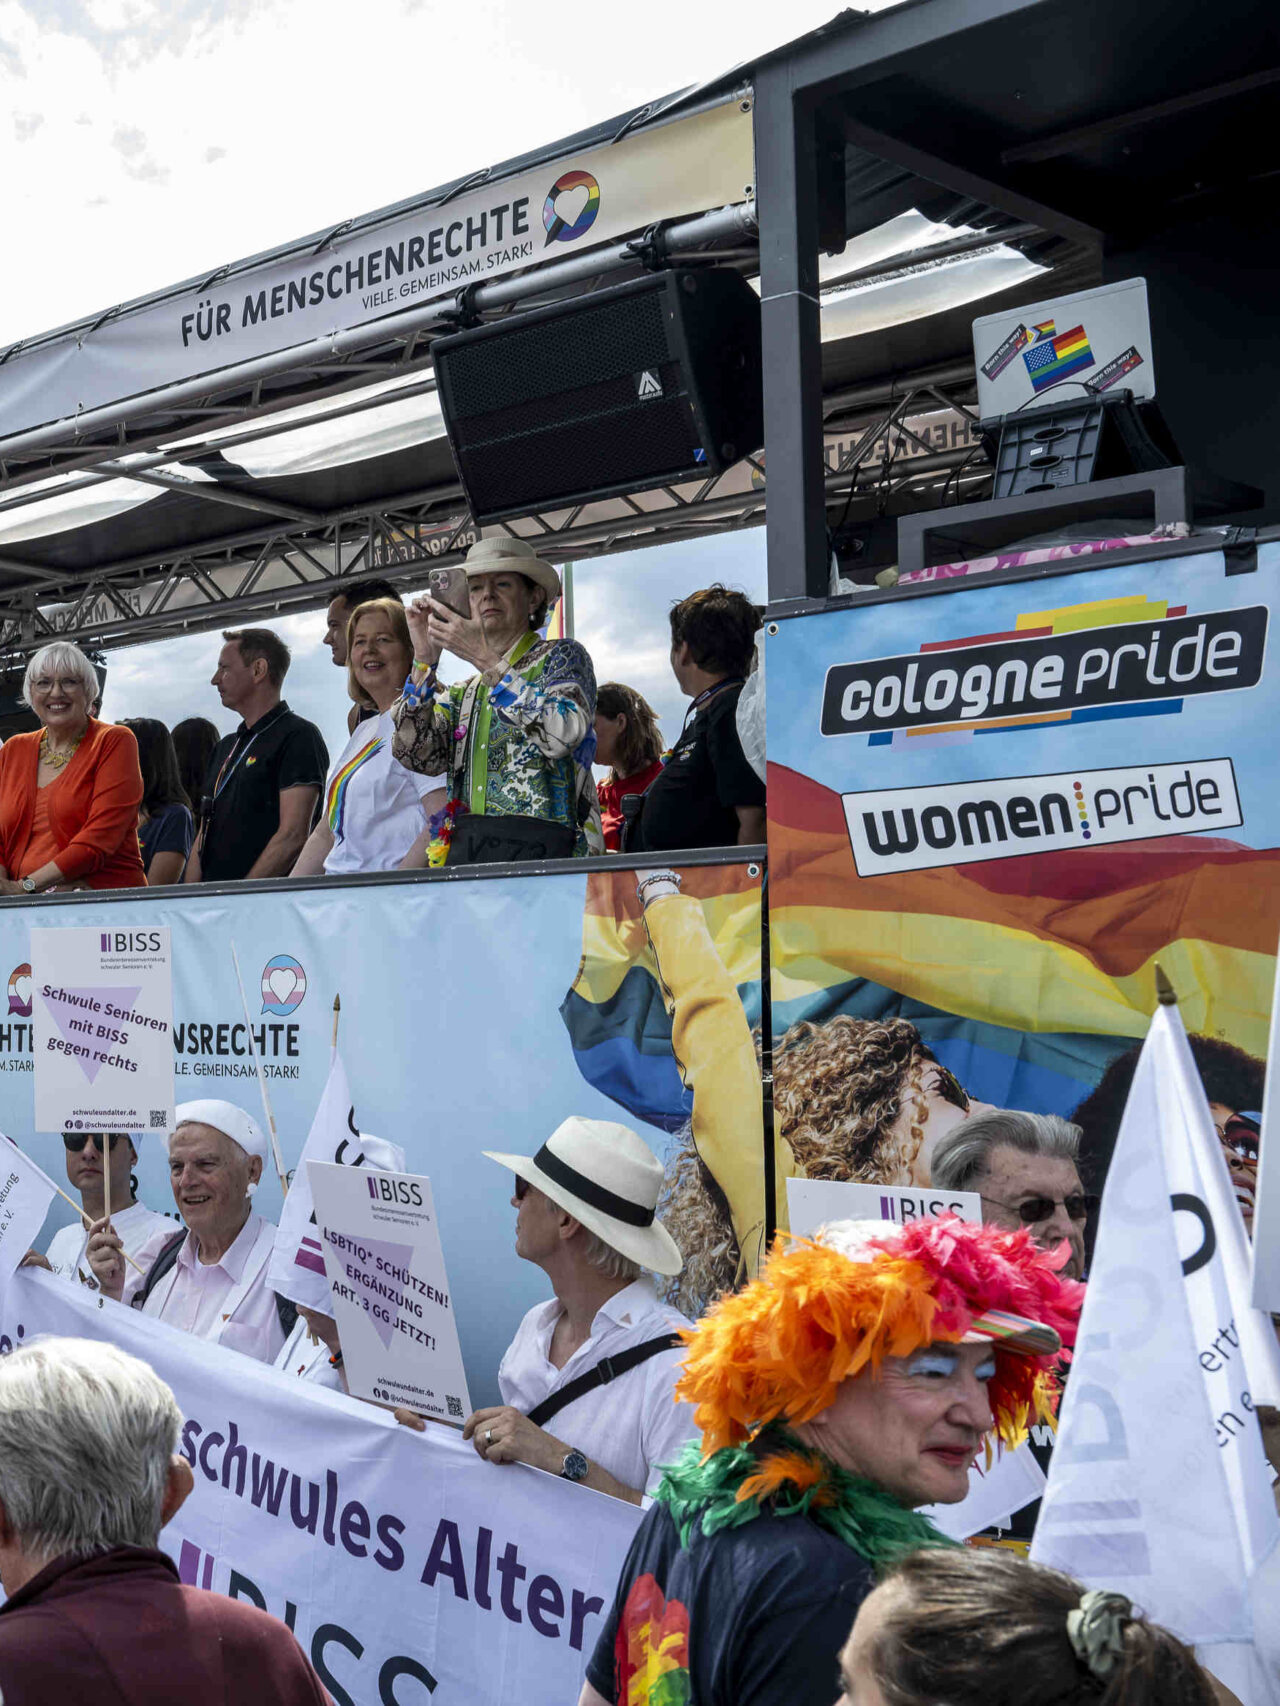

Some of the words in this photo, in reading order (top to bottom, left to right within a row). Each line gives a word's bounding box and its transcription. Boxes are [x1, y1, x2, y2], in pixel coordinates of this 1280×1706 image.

[181, 301, 232, 348] FÜR
[241, 197, 530, 328] MENSCHENRECHTE
[361, 289, 398, 311] VIELE.
[399, 259, 485, 299] GEMEINSAM.
[487, 241, 534, 270] STARK!
[840, 654, 1066, 722] cologne
[1075, 623, 1243, 694] pride
[862, 792, 1074, 857] women
[1093, 769, 1223, 829] pride
[115, 932, 161, 952] BISS
[42, 984, 102, 1013] Schwule
[104, 1003, 168, 1033] Senioren
[69, 1018, 94, 1036] mit
[96, 1025, 130, 1046] BISS
[47, 1037, 91, 1057] gegen
[93, 1050, 138, 1073] rechts
[263, 1064, 300, 1079] STARK!
[72, 1109, 137, 1117] schwuleundalter.de
[84, 1121, 147, 1130] @schwuleundalter
[380, 1178, 423, 1207] BISS
[346, 1263, 423, 1319] ERGÄNZUNG
[375, 1256, 449, 1309] SCHÜTZEN!
[332, 1280, 360, 1307] ART.
[362, 1297, 370, 1311] 3
[372, 1303, 391, 1324] GG
[392, 1316, 436, 1352] JETZT!
[180, 1418, 407, 1573] schwules
[420, 1517, 606, 1653] Alter
